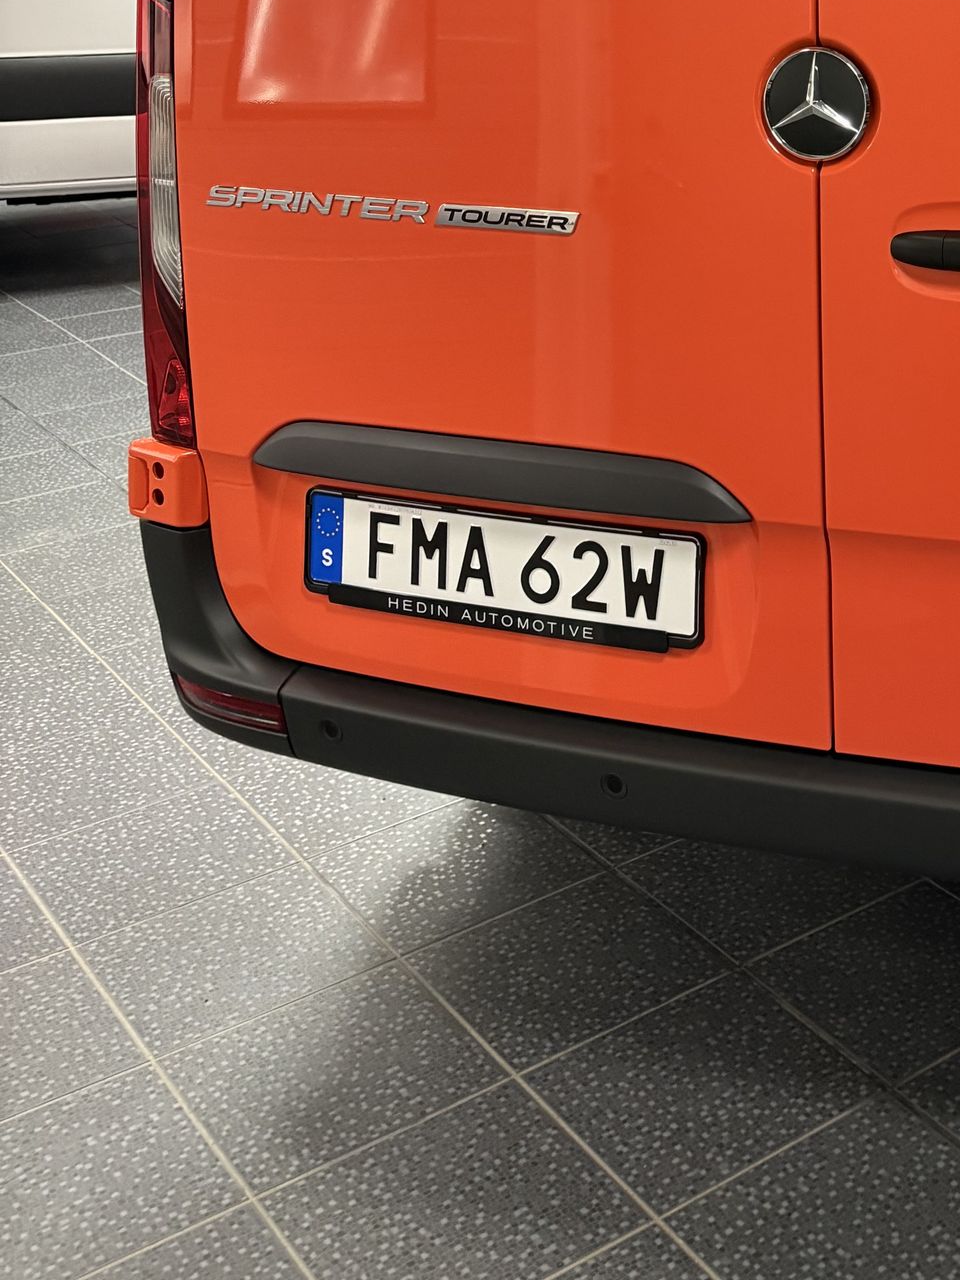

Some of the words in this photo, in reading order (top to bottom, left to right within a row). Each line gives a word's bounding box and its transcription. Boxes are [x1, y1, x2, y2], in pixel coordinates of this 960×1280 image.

[205, 184, 430, 224] SPRINTER
[444, 207, 569, 231] TOURER
[321, 548, 333, 568] S
[367, 510, 495, 598] FMA
[519, 534, 665, 621] 62W
[387, 596, 450, 618] HEDIN
[460, 609, 595, 640] AUTOMOTIVE
